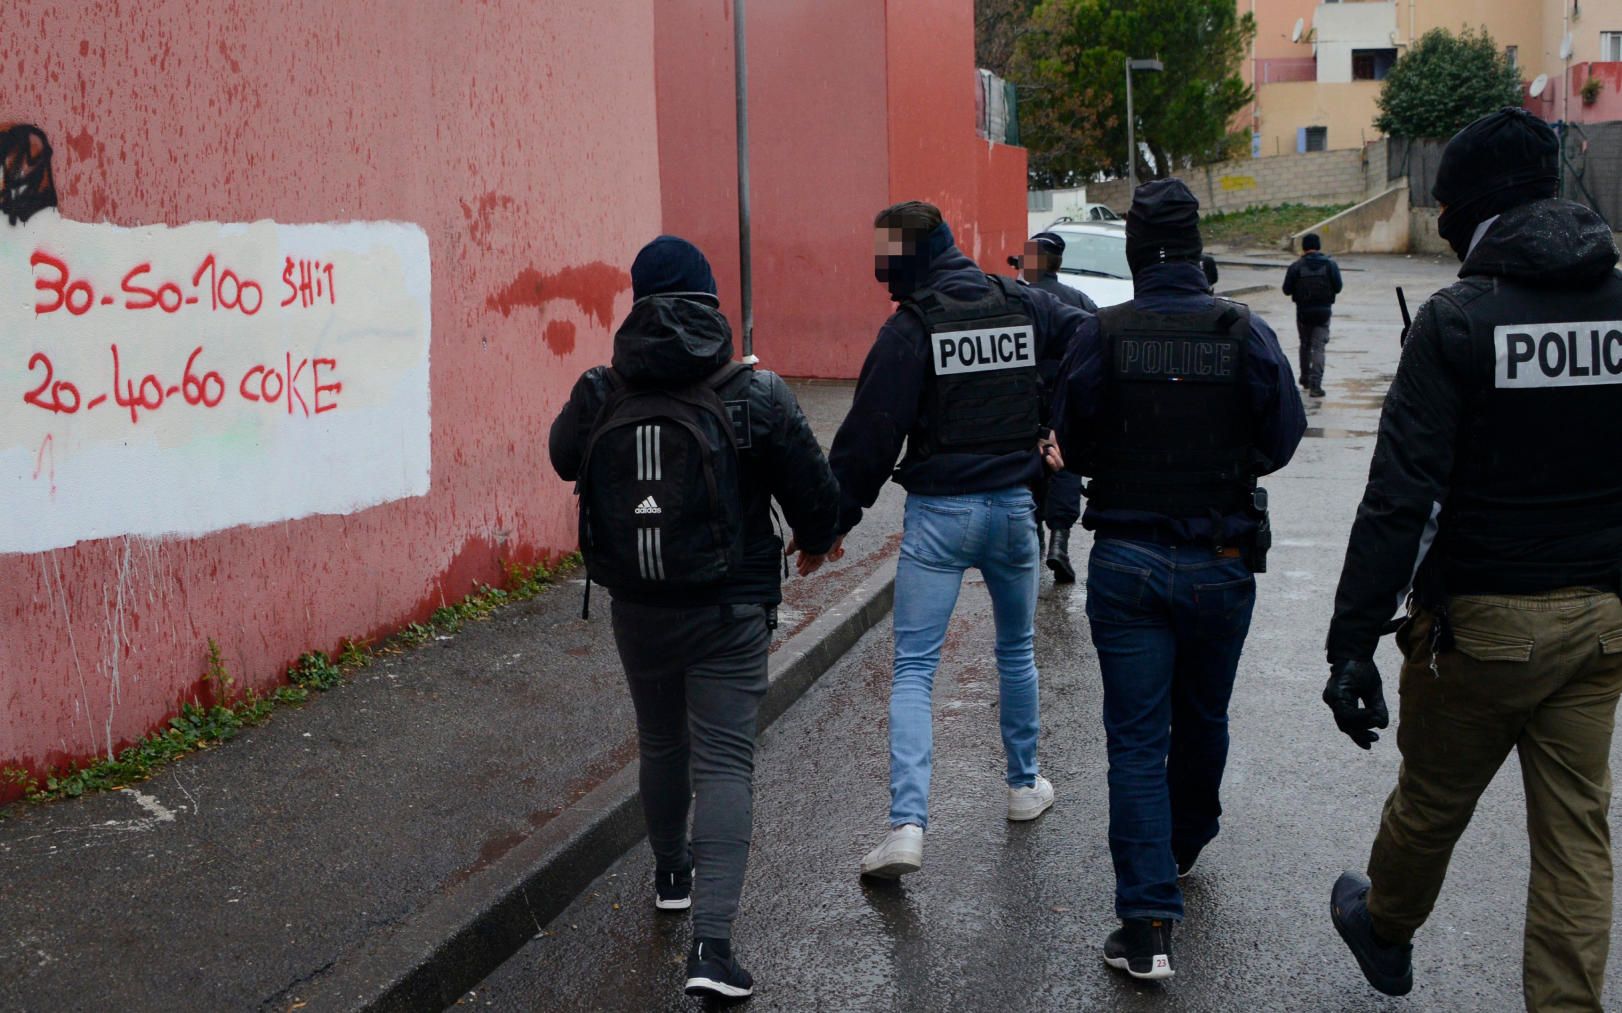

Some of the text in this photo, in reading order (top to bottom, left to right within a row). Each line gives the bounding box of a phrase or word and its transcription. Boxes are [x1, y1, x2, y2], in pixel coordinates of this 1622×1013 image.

[940, 332, 1029, 368] POLICE
[1120, 340, 1232, 376] POLICE
[1506, 329, 1622, 379] POLIC
[239, 352, 342, 418] COKE
[1156, 959, 1166, 967] 23
